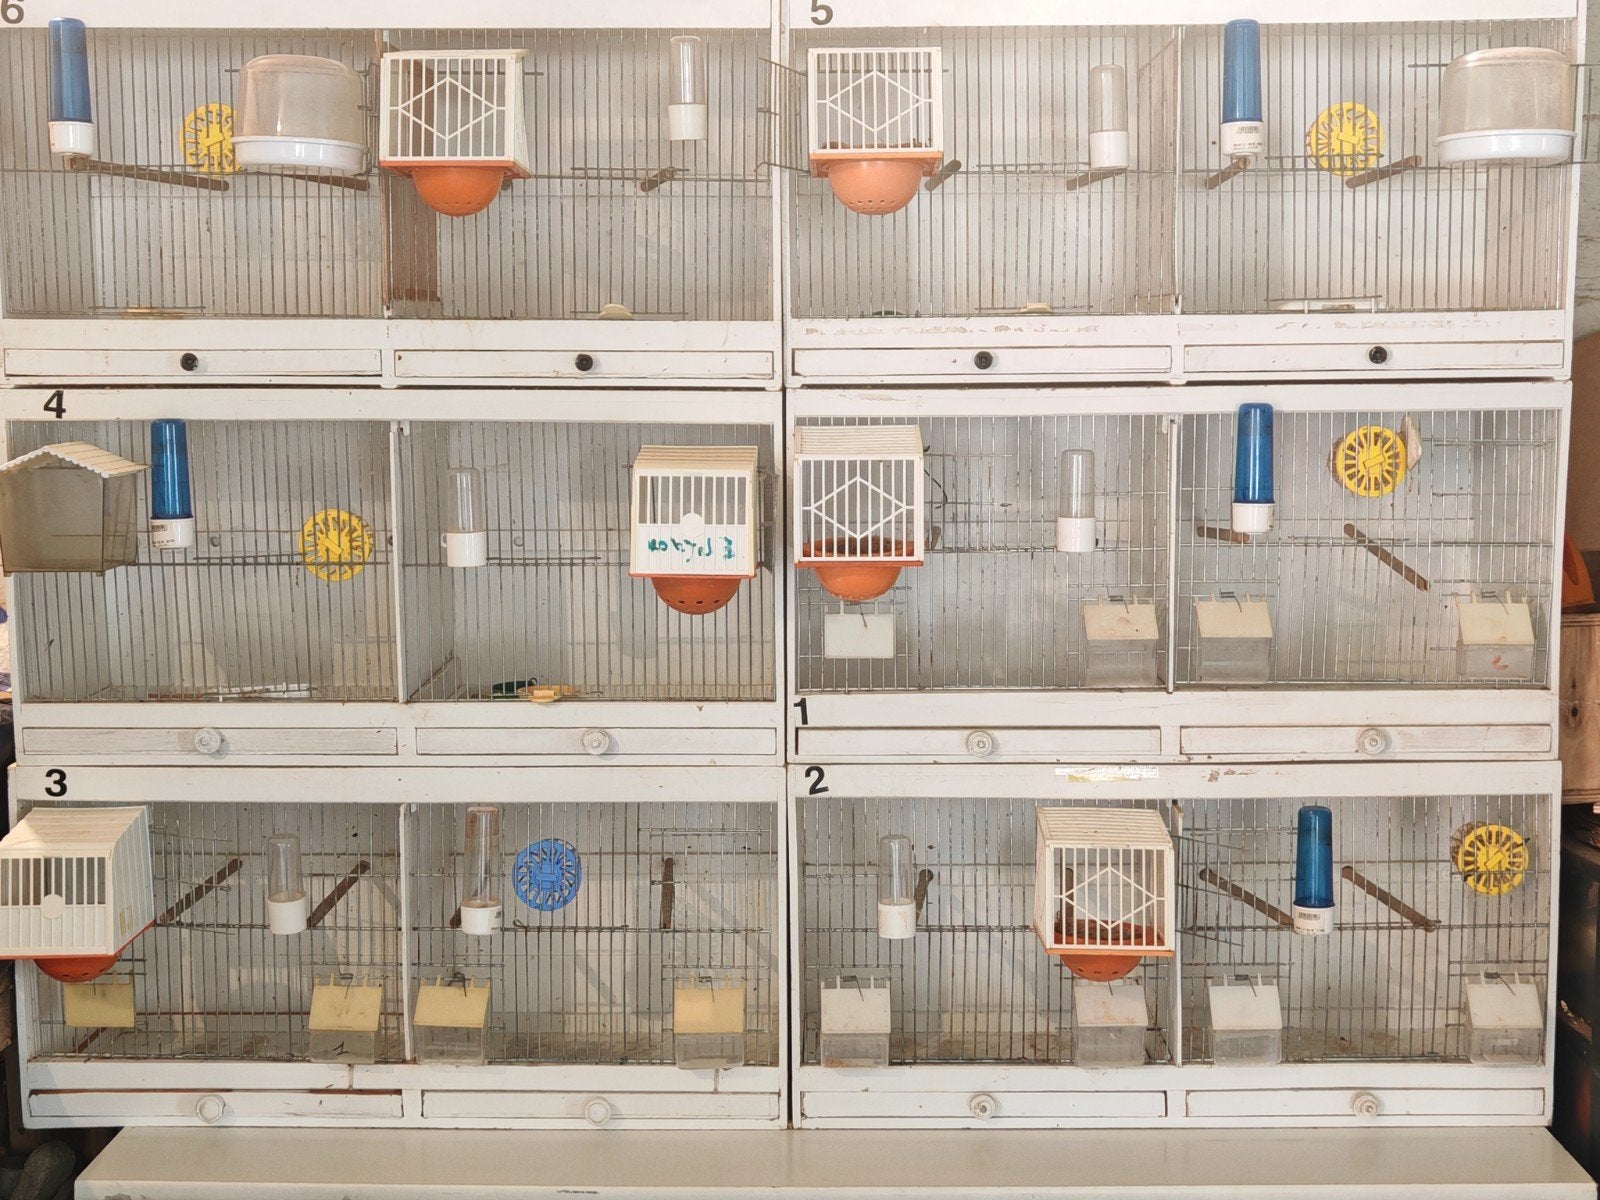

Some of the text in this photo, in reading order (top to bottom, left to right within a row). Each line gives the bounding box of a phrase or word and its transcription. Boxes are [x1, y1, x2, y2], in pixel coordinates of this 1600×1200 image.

[1, 0, 24, 24] 6
[811, 0, 833, 25] 5
[43, 390, 67, 419] 4
[793, 697, 808, 725] 1
[44, 769, 67, 797] 3
[805, 766, 829, 796] 2
